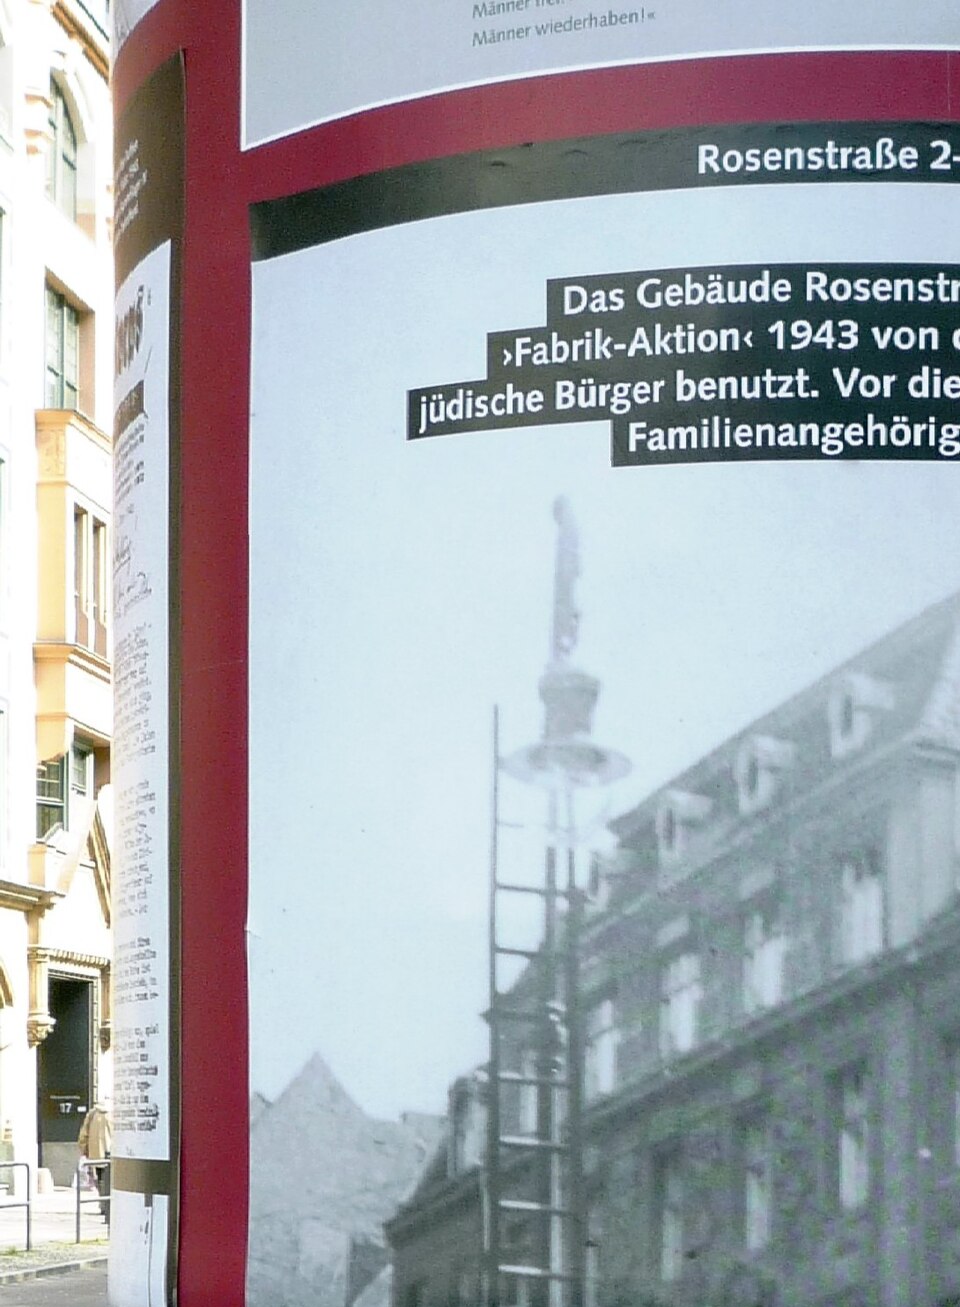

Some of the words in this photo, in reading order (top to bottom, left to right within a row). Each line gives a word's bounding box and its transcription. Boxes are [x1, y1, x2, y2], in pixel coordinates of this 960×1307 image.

[472, 24, 530, 47] Männer
[535, 8, 656, 36] wiederhaben!«
[697, 137, 918, 175] Rosenstraße
[563, 285, 626, 316] Das
[636, 270, 792, 310] Gebäude
[502, 322, 754, 368] ›Fabrik-Aktion‹
[767, 320, 859, 351] 1943
[870, 325, 940, 351] von
[418, 384, 545, 435] jüdische
[555, 378, 665, 416] Bürger
[675, 367, 820, 403] benutzt.
[831, 367, 897, 399] Vor
